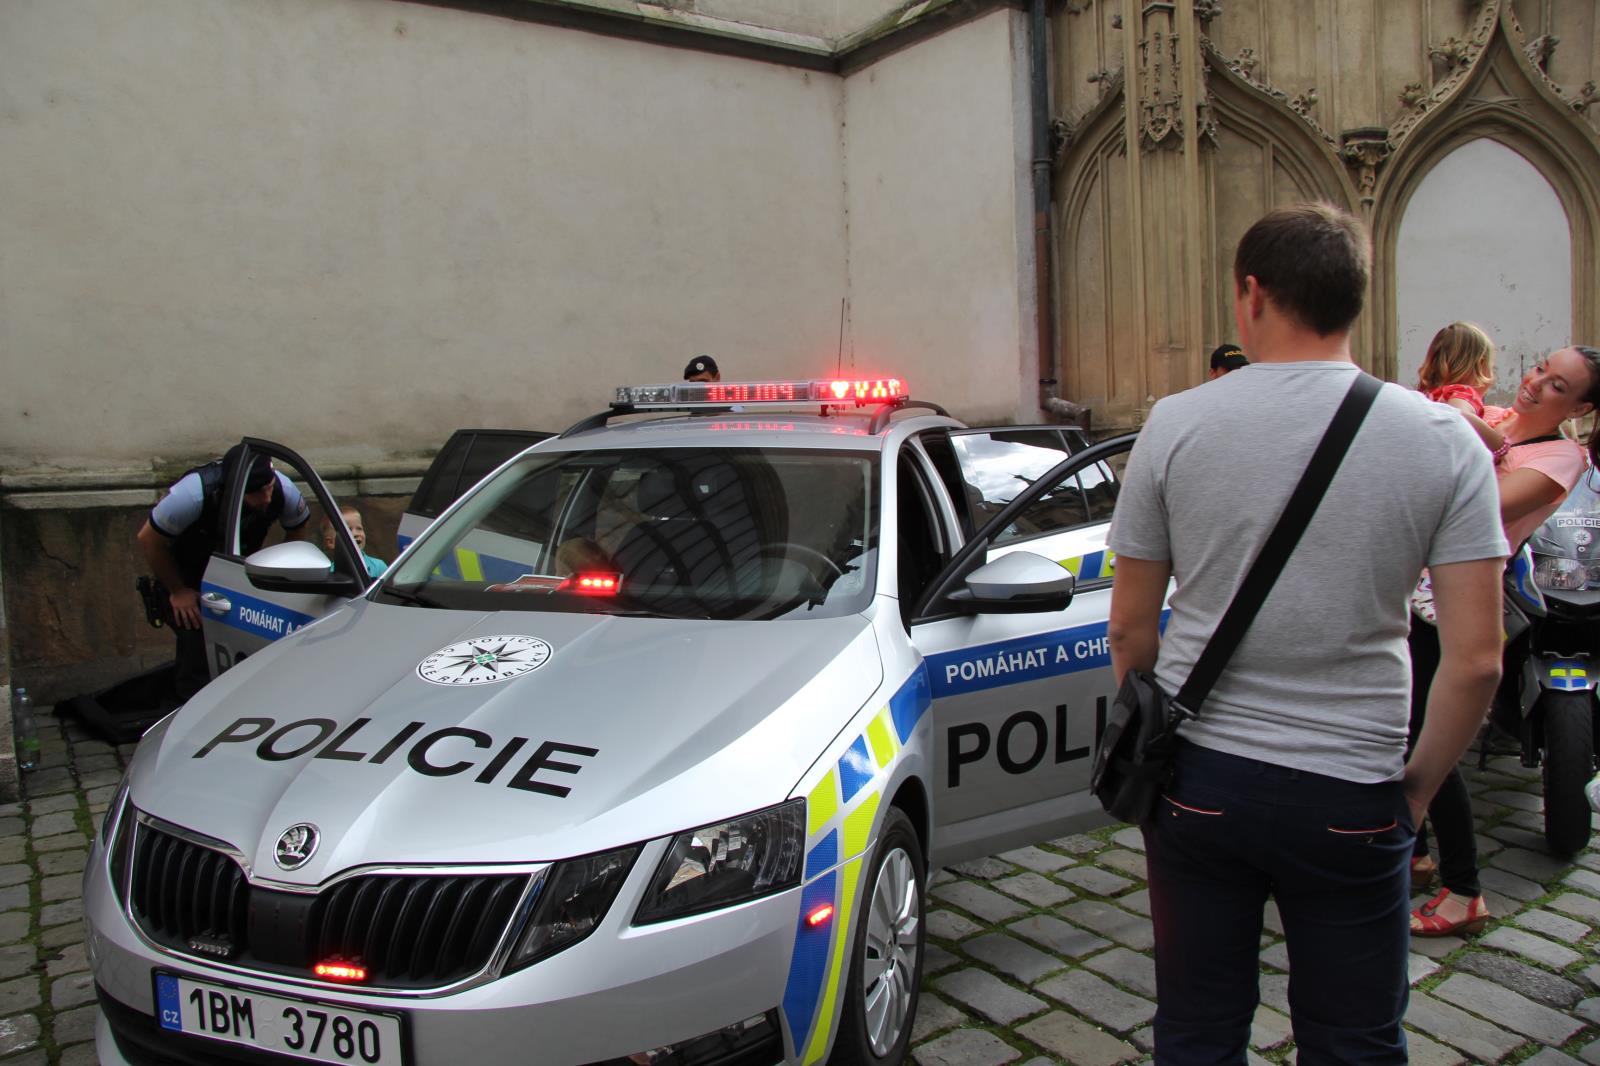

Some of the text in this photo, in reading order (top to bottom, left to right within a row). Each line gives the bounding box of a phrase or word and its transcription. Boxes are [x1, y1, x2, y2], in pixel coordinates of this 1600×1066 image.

[239, 606, 293, 636] POMÁHAT A
[468, 637, 544, 649] POLICIE
[945, 636, 1111, 684] POMÁHAT A CHR
[437, 652, 546, 683] REPUBLIKY
[192, 717, 600, 799] POLICIE
[948, 696, 1107, 788] POLI
[163, 1009, 179, 1024] CZ
[190, 988, 381, 1064] 1BM 3780
